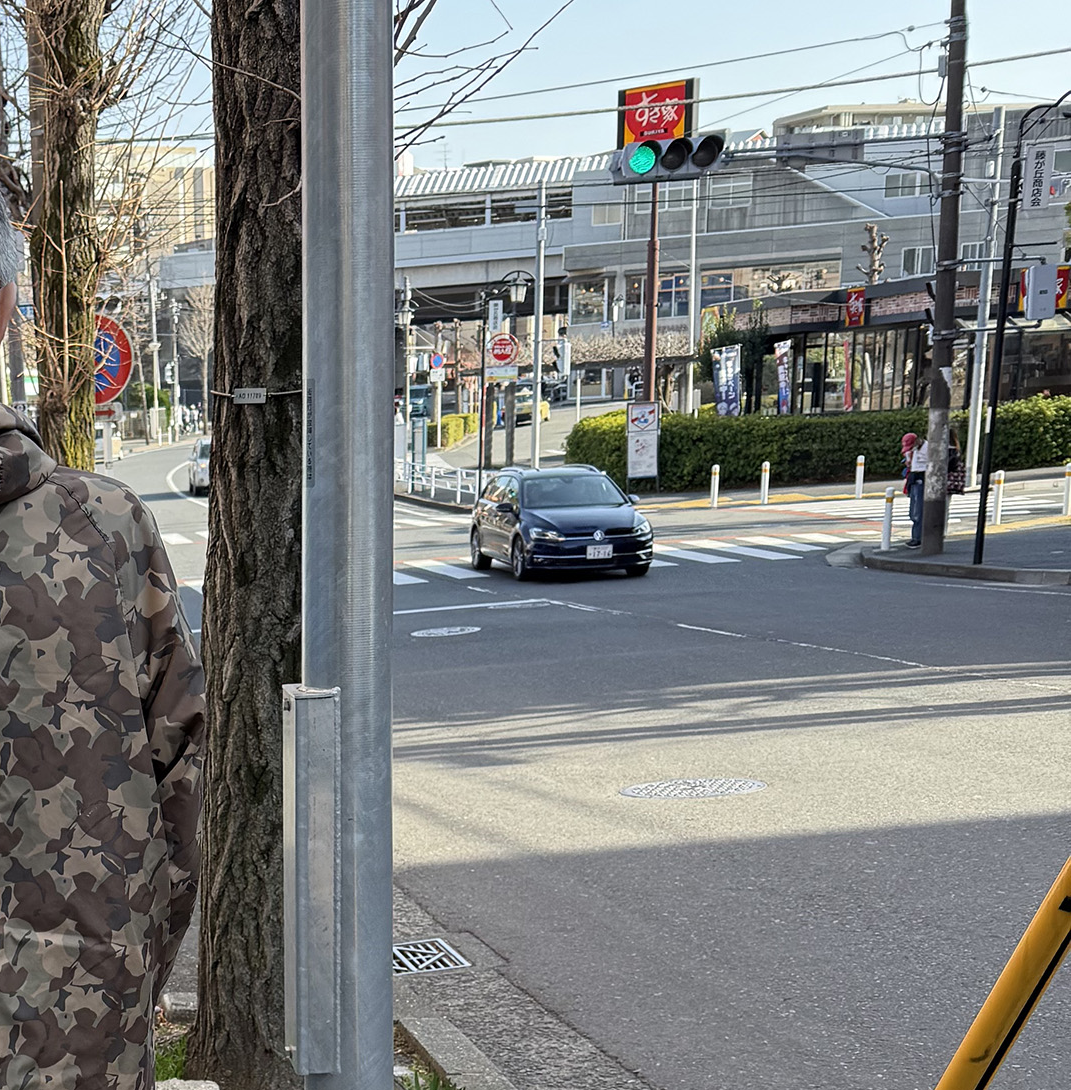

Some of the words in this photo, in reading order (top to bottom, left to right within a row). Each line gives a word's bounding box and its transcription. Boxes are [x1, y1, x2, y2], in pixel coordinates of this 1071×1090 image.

[635, 92, 678, 127] すき家
[1031, 150, 1046, 207] 藤が丘商店会
